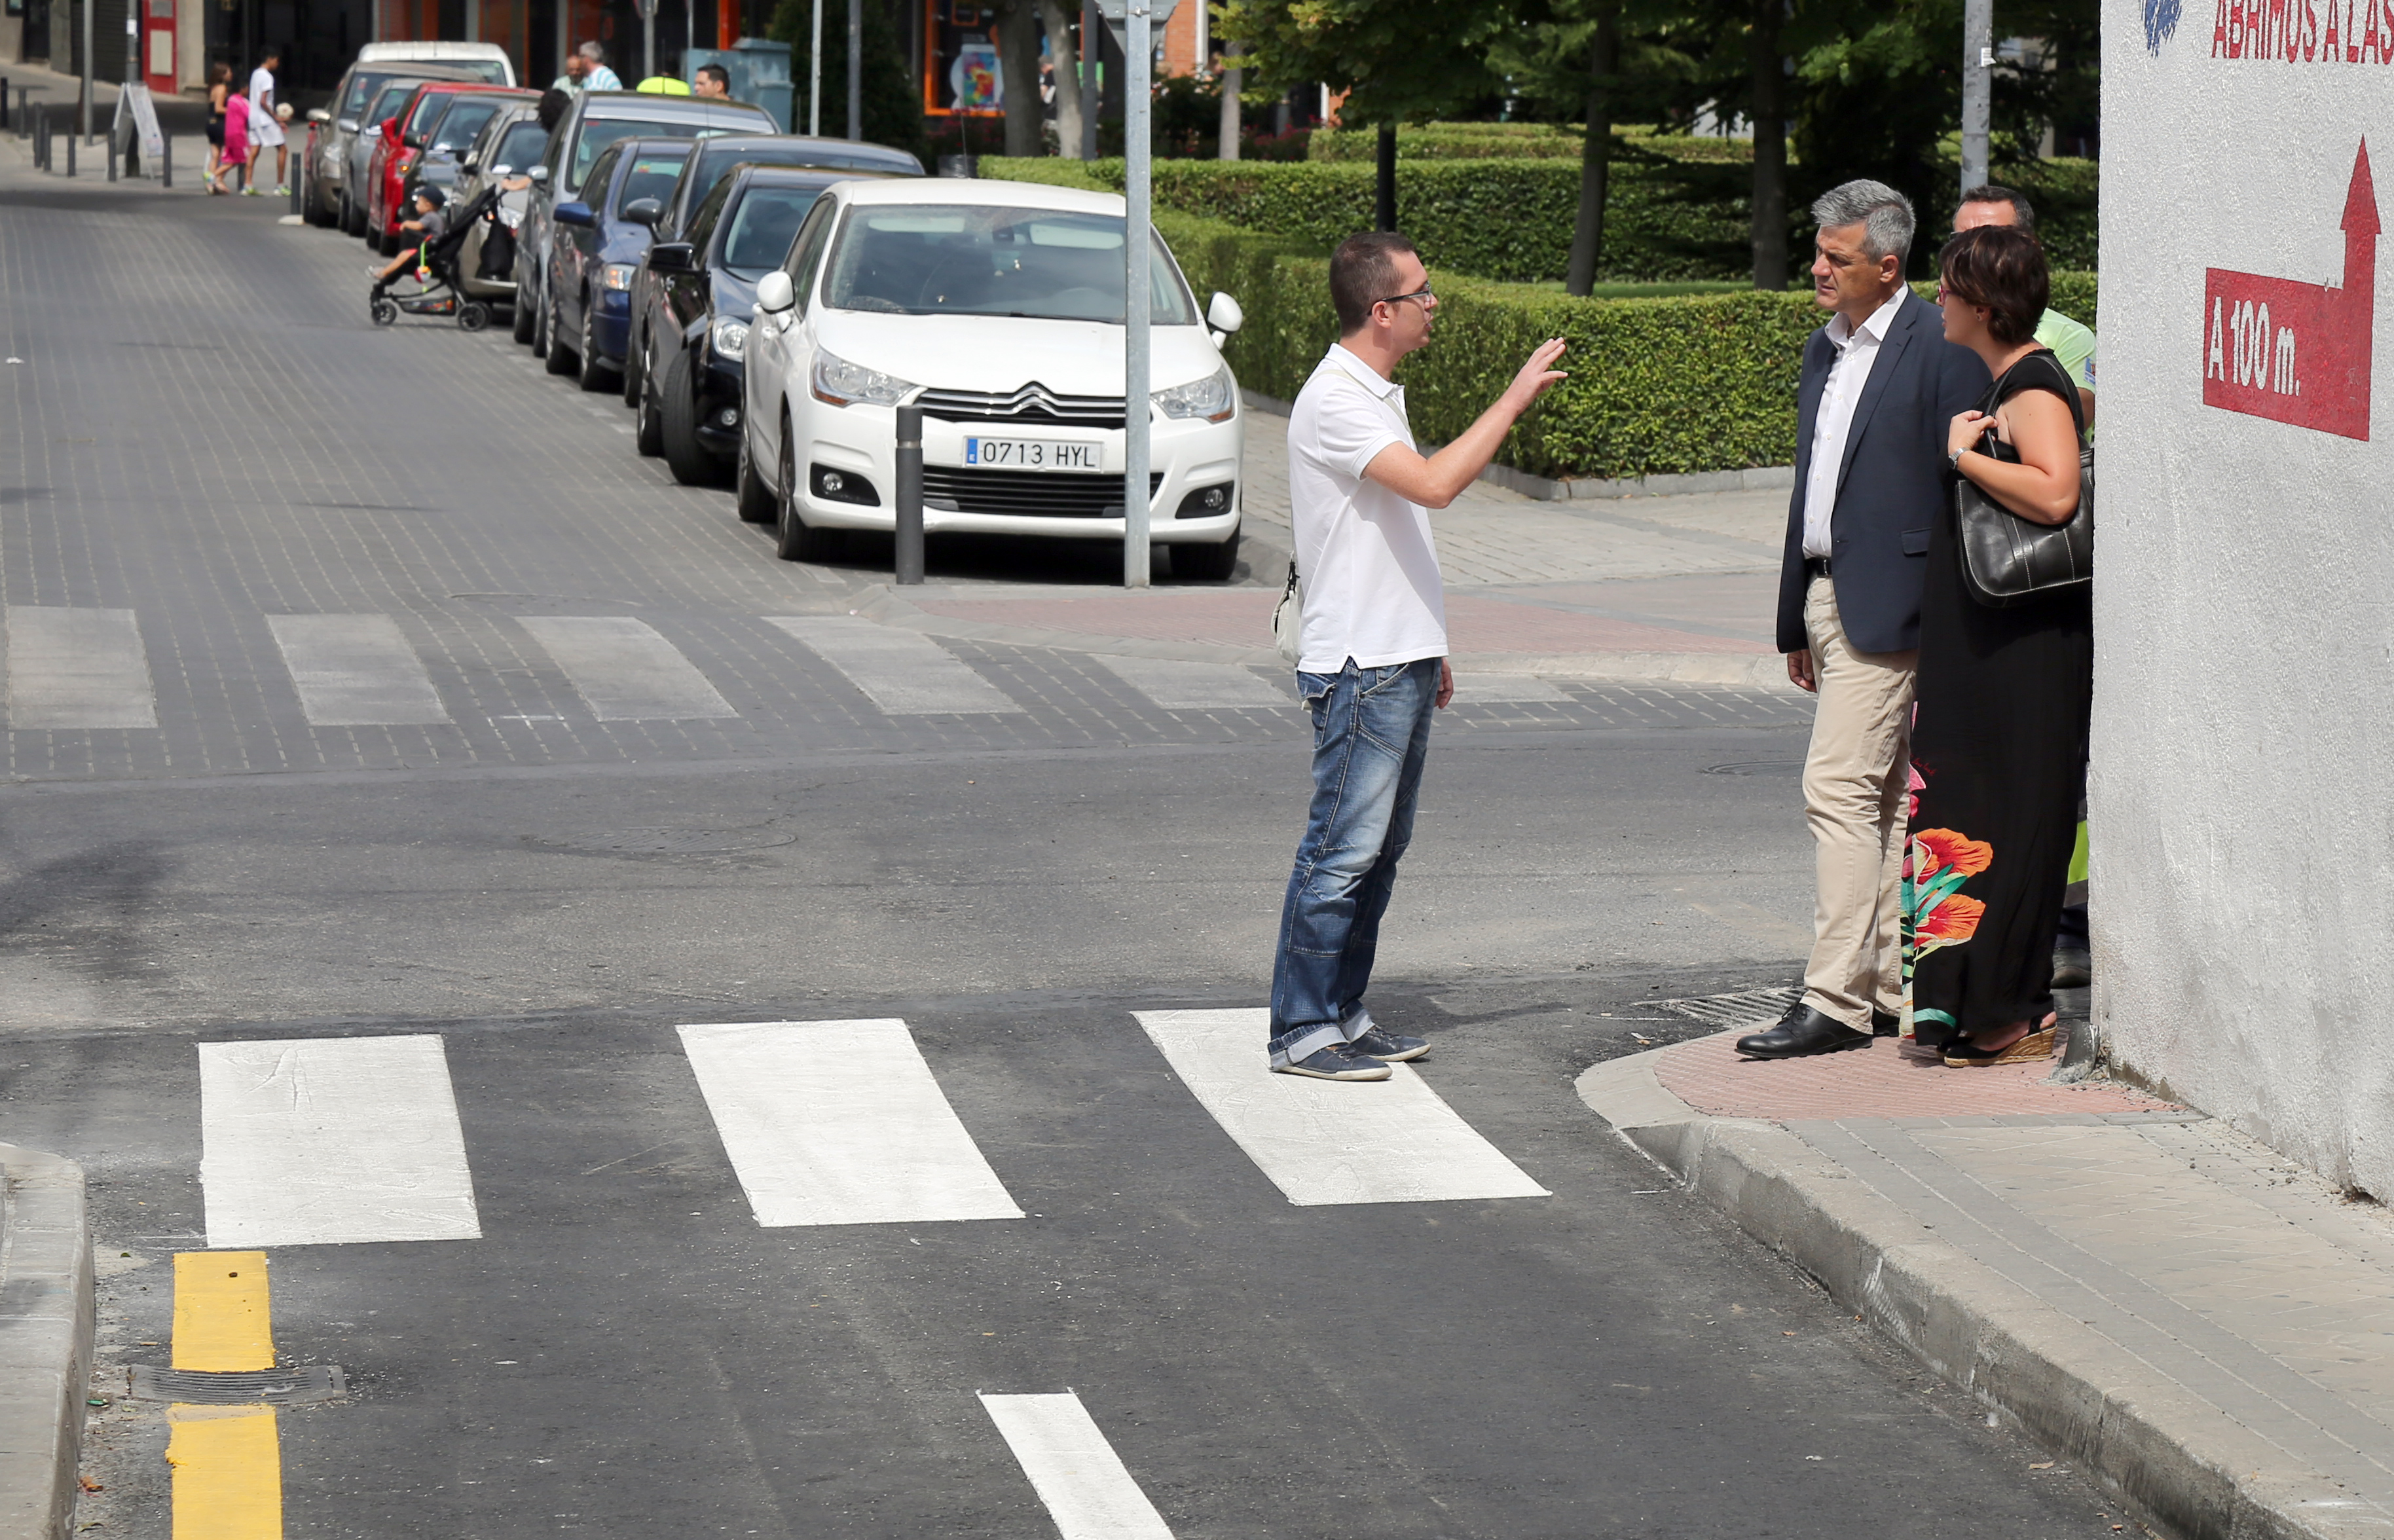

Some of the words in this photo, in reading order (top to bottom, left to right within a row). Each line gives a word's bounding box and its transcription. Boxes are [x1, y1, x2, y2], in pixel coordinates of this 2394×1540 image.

[2212, 0, 2317, 64] ABRIMOS
[2323, 0, 2339, 62] A
[2347, 0, 2394, 65] LAS
[2207, 296, 2225, 382] A
[2230, 300, 2270, 390] 100
[2274, 325, 2300, 397] m.
[984, 442, 1042, 464] 0713
[1056, 445, 1096, 467] HYL
